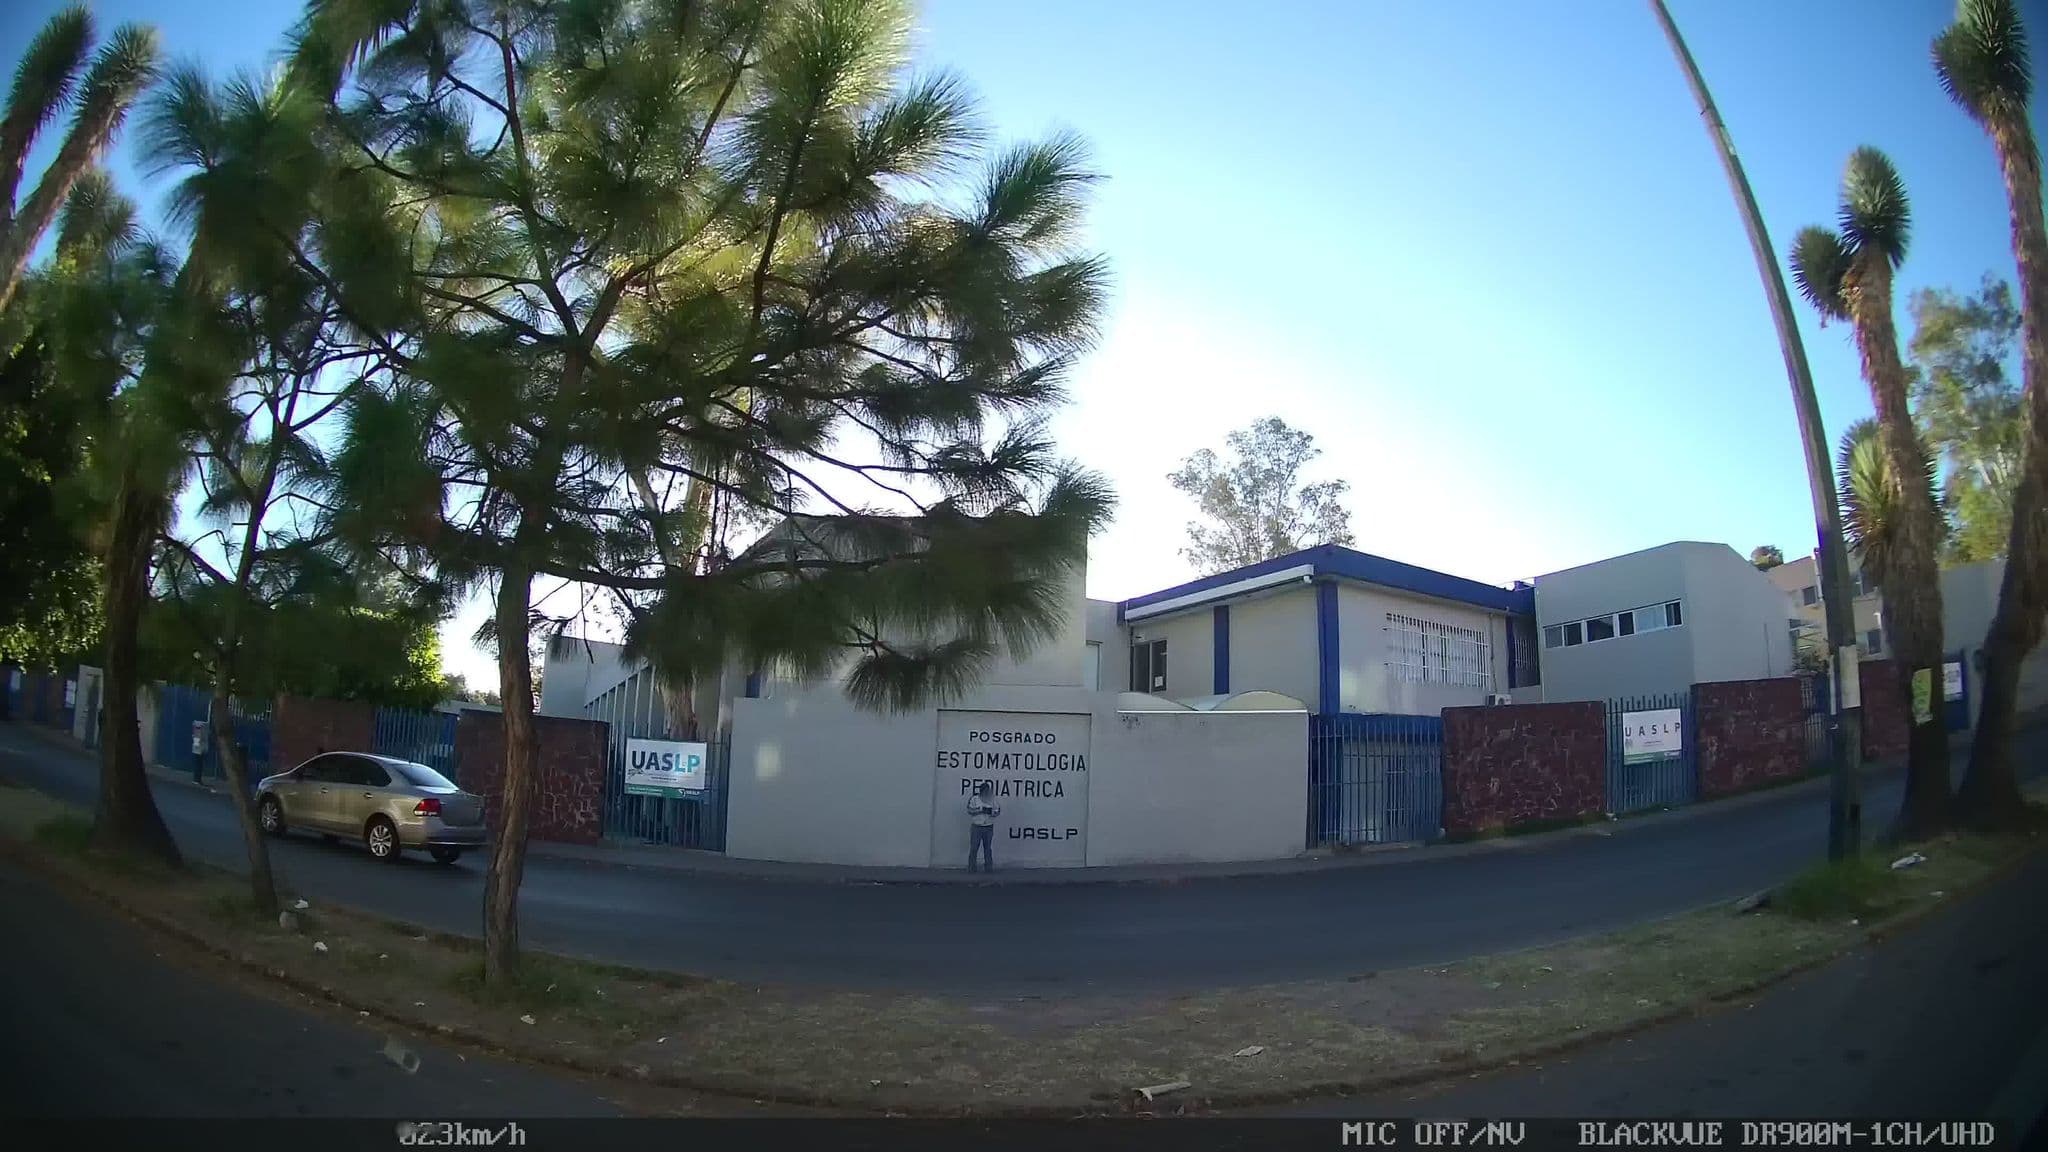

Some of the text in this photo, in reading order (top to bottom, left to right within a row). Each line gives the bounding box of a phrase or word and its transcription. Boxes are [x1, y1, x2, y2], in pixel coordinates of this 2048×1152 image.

[969, 731, 1056, 744] POSGRADO
[631, 750, 701, 773] UASLP
[937, 751, 1087, 771] ESTOMATOLOGIA
[1009, 827, 1078, 840] UASLP
